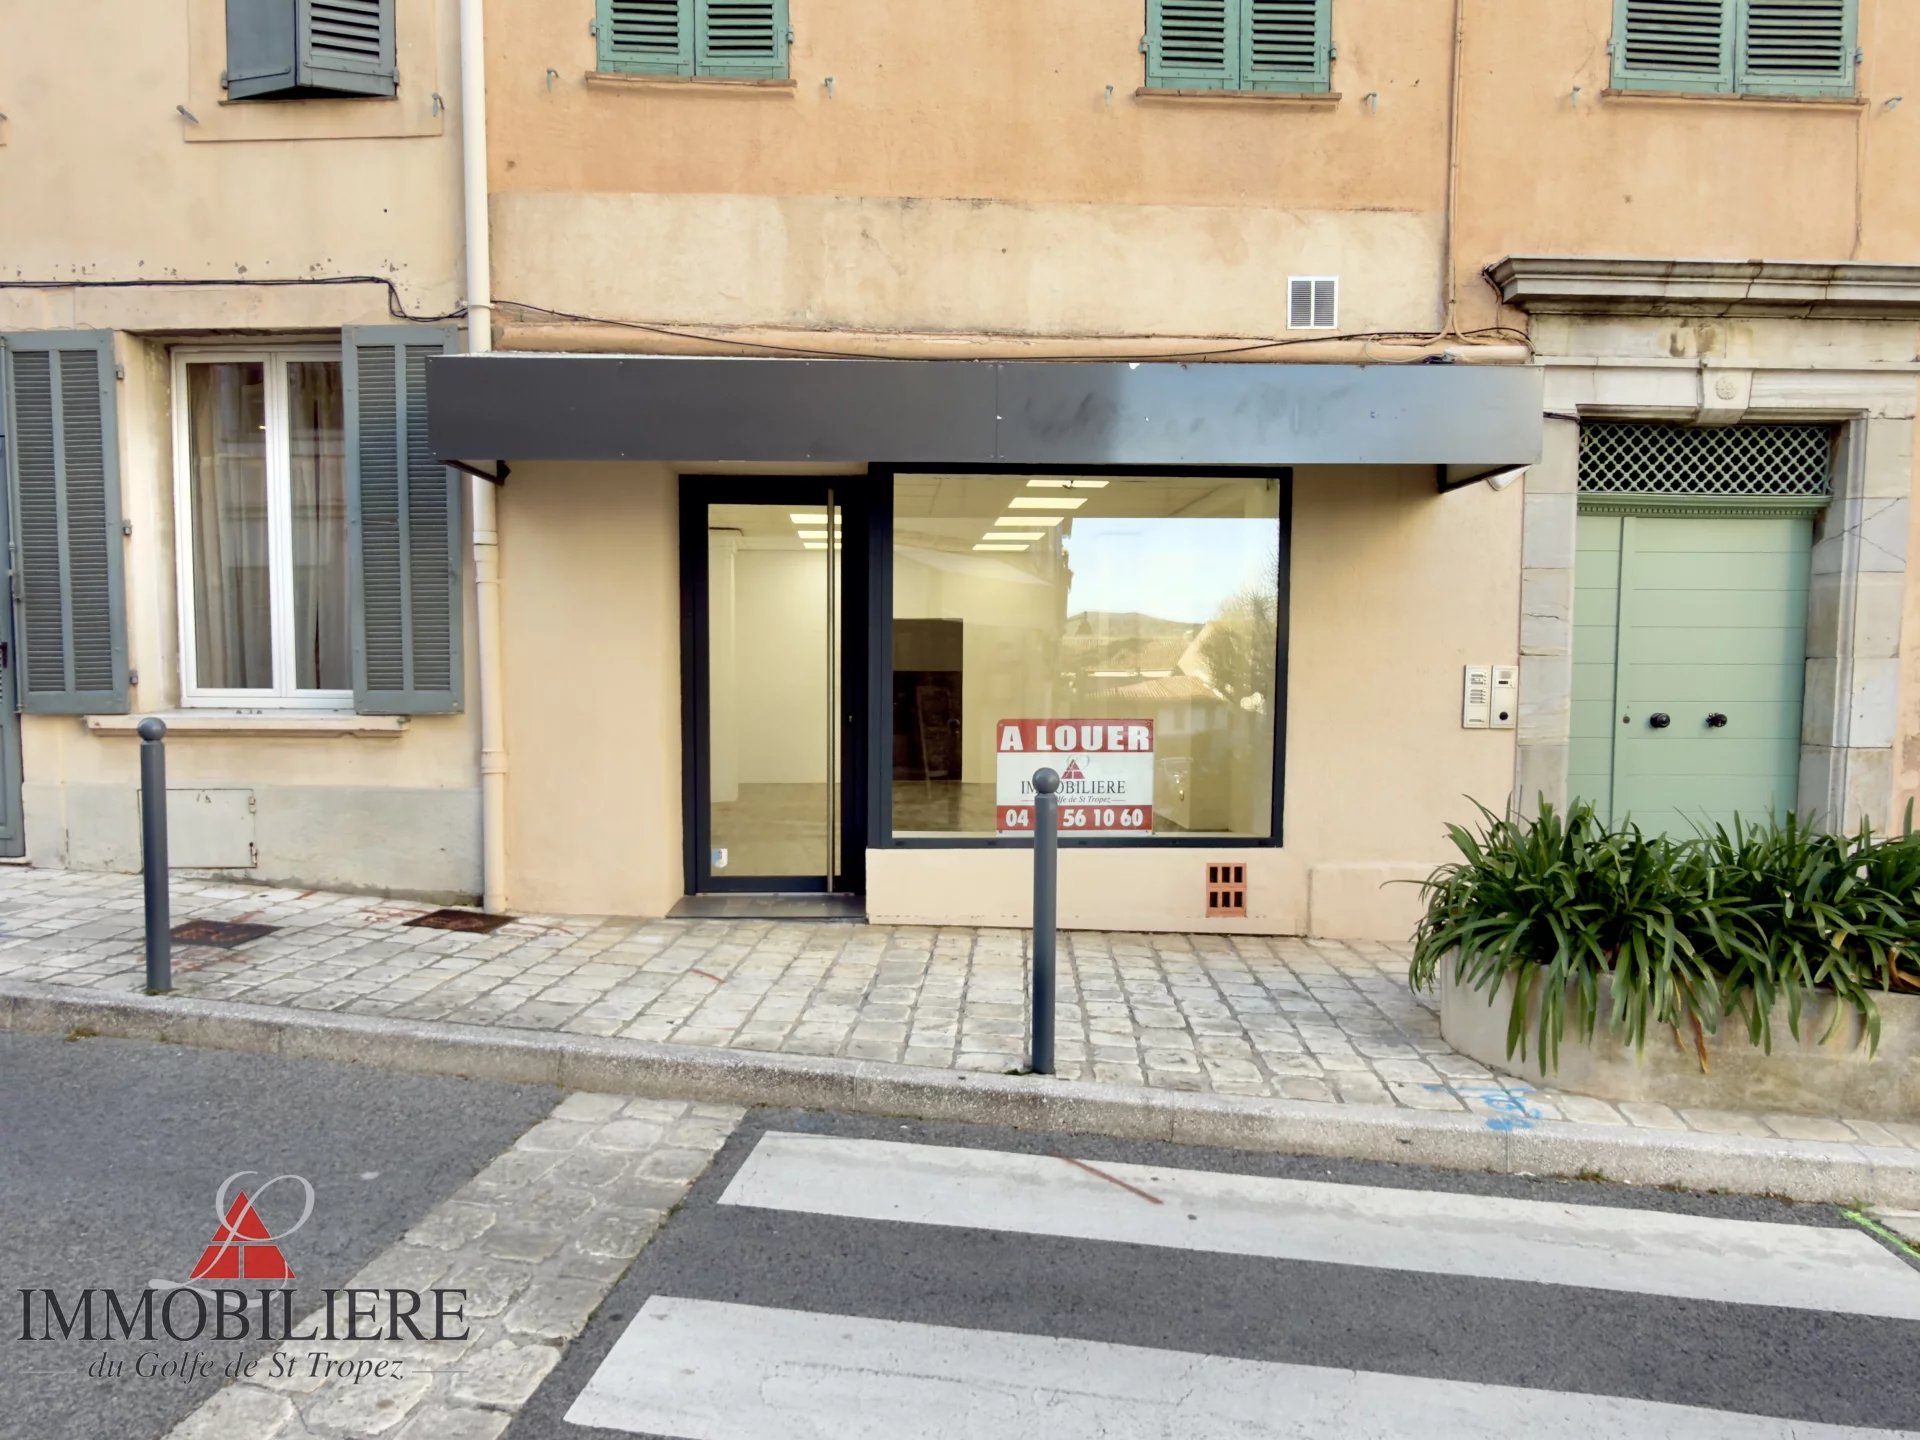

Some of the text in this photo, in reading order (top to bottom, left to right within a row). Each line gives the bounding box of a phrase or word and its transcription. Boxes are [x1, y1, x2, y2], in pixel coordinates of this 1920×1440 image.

[1000, 725, 1149, 751] A LOUER
[1021, 780, 1126, 794] IMOBILIERE
[1069, 795, 1077, 803] de
[1079, 795, 1086, 803] St
[1087, 795, 1111, 804] Tropez
[1006, 809, 1143, 827] 04 56 10 60
